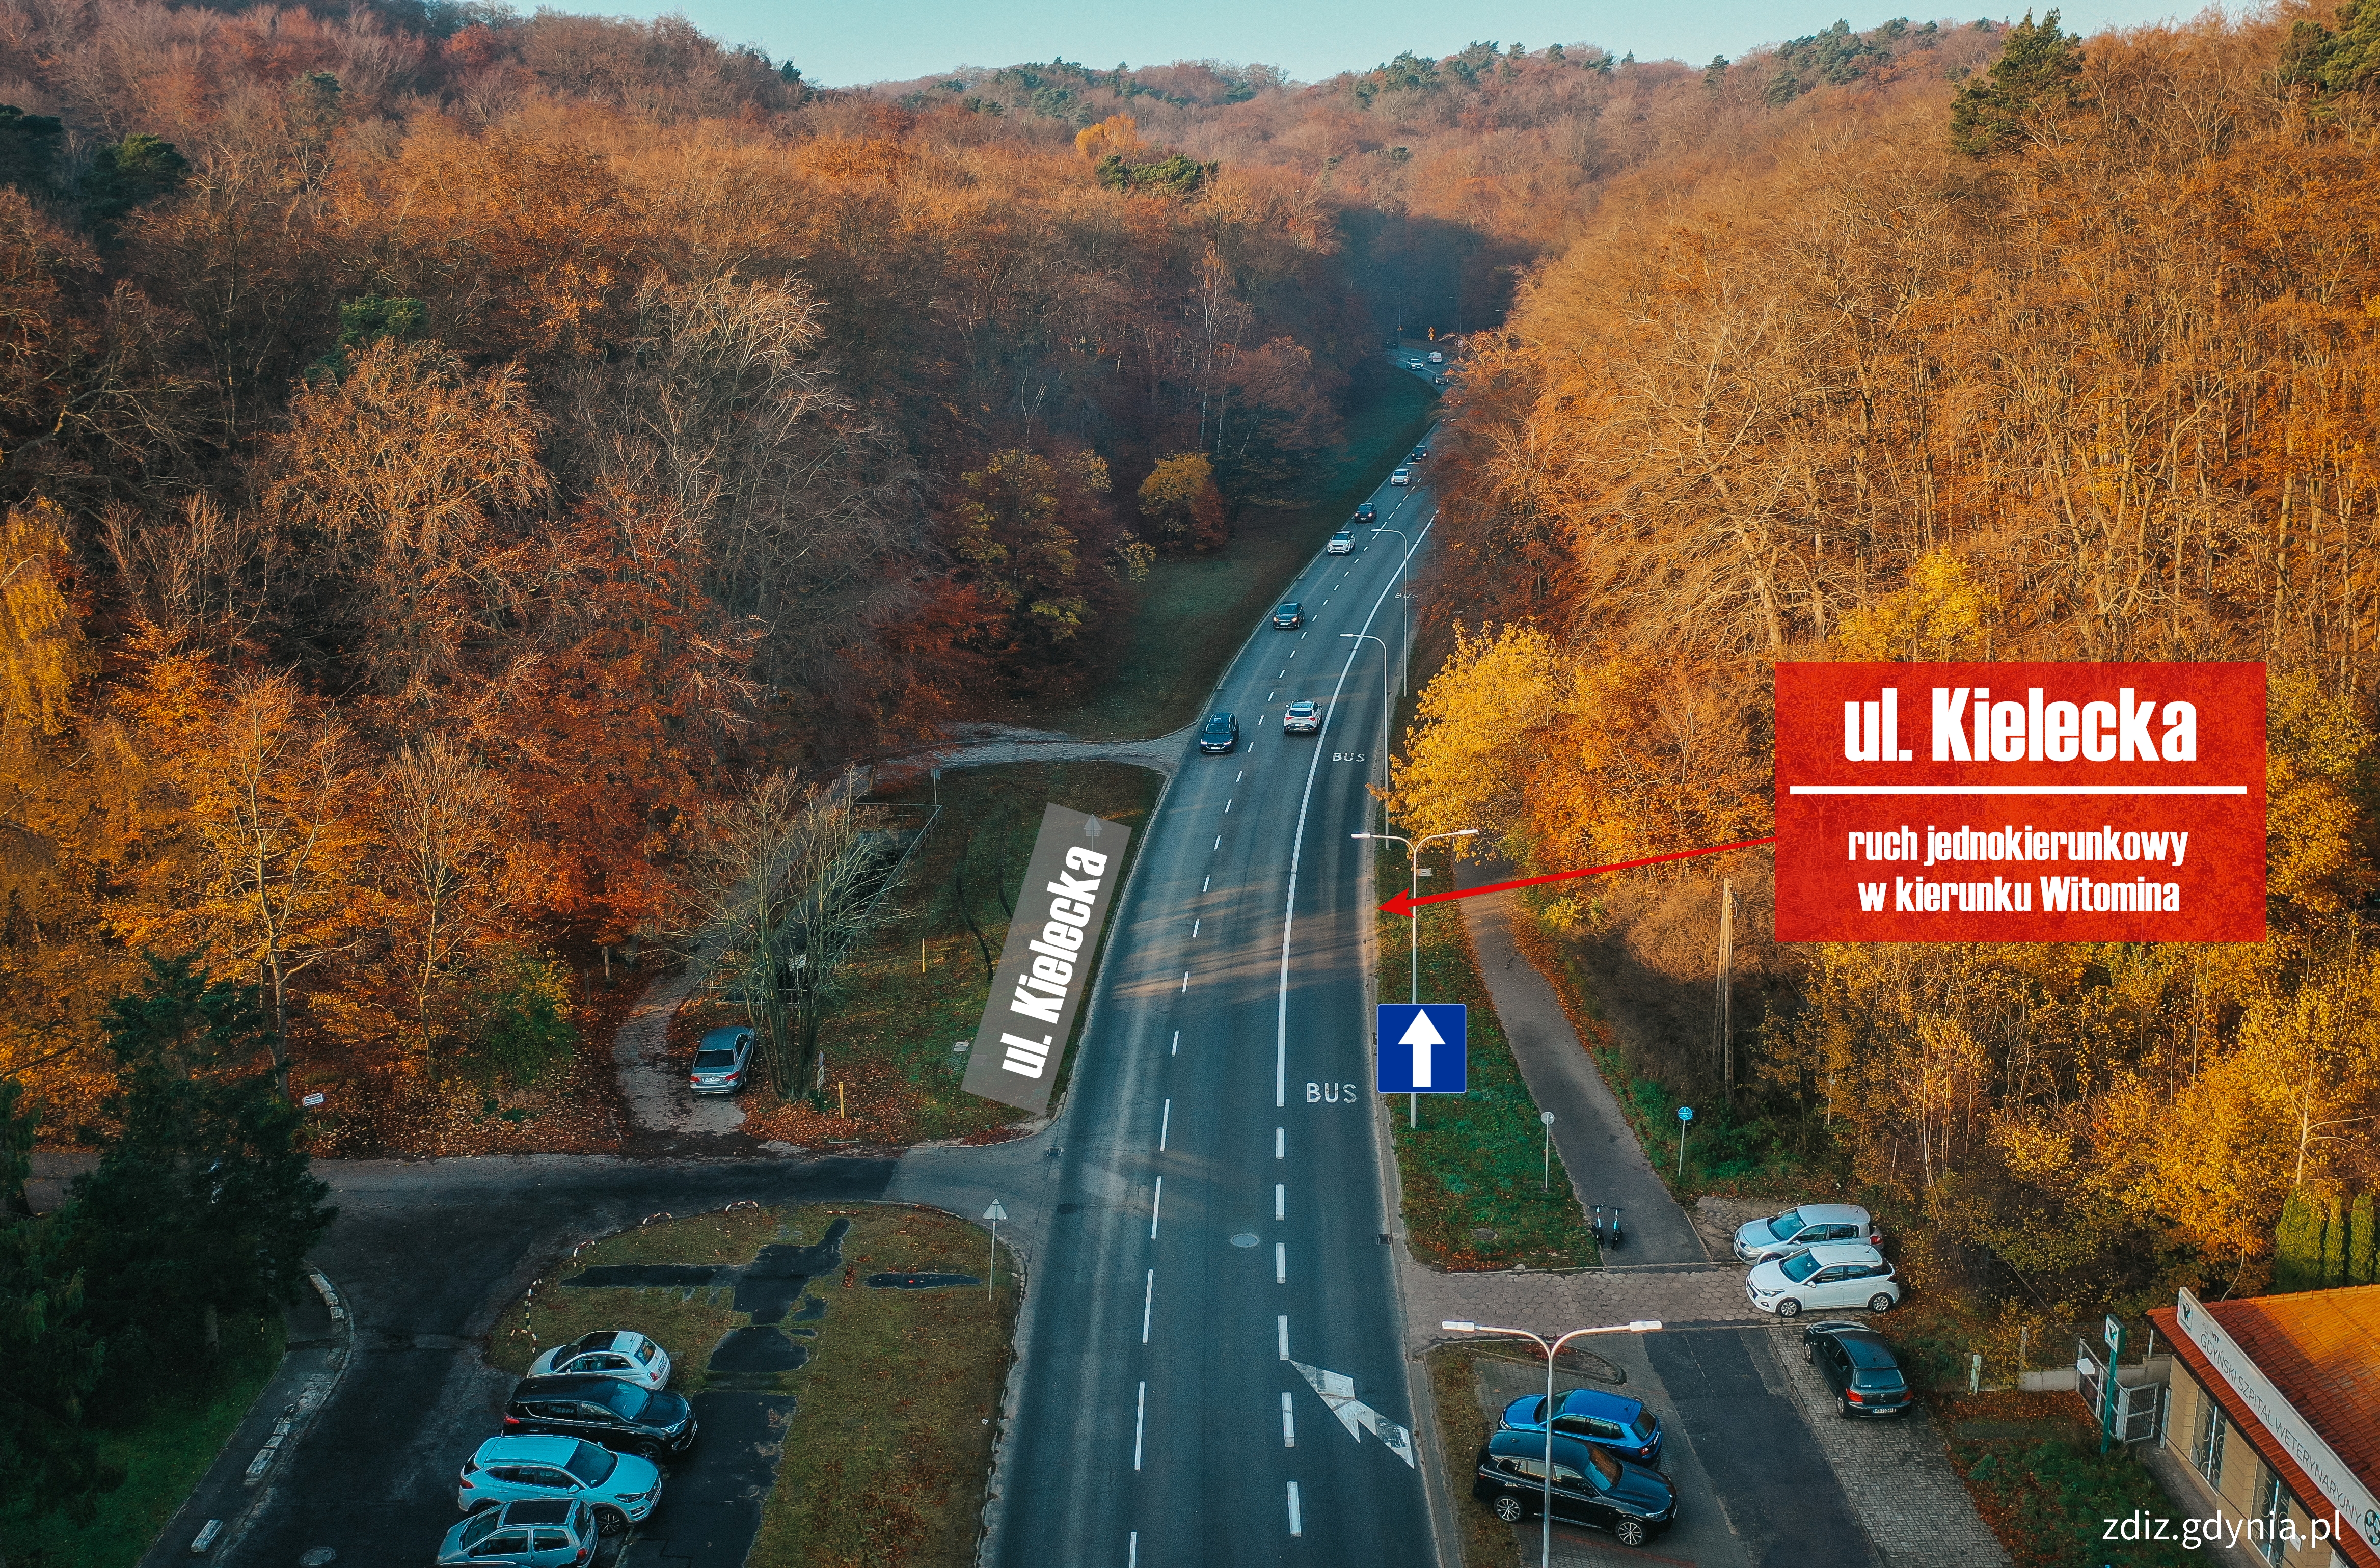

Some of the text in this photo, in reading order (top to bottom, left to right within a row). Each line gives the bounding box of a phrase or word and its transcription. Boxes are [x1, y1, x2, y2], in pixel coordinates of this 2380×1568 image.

[1333, 752, 1366, 762] BUS
[1306, 1082, 1357, 1103] BUS
[2201, 1333, 2362, 1524] GDYŃSKI SZPITAL WETERYNARYJNY
